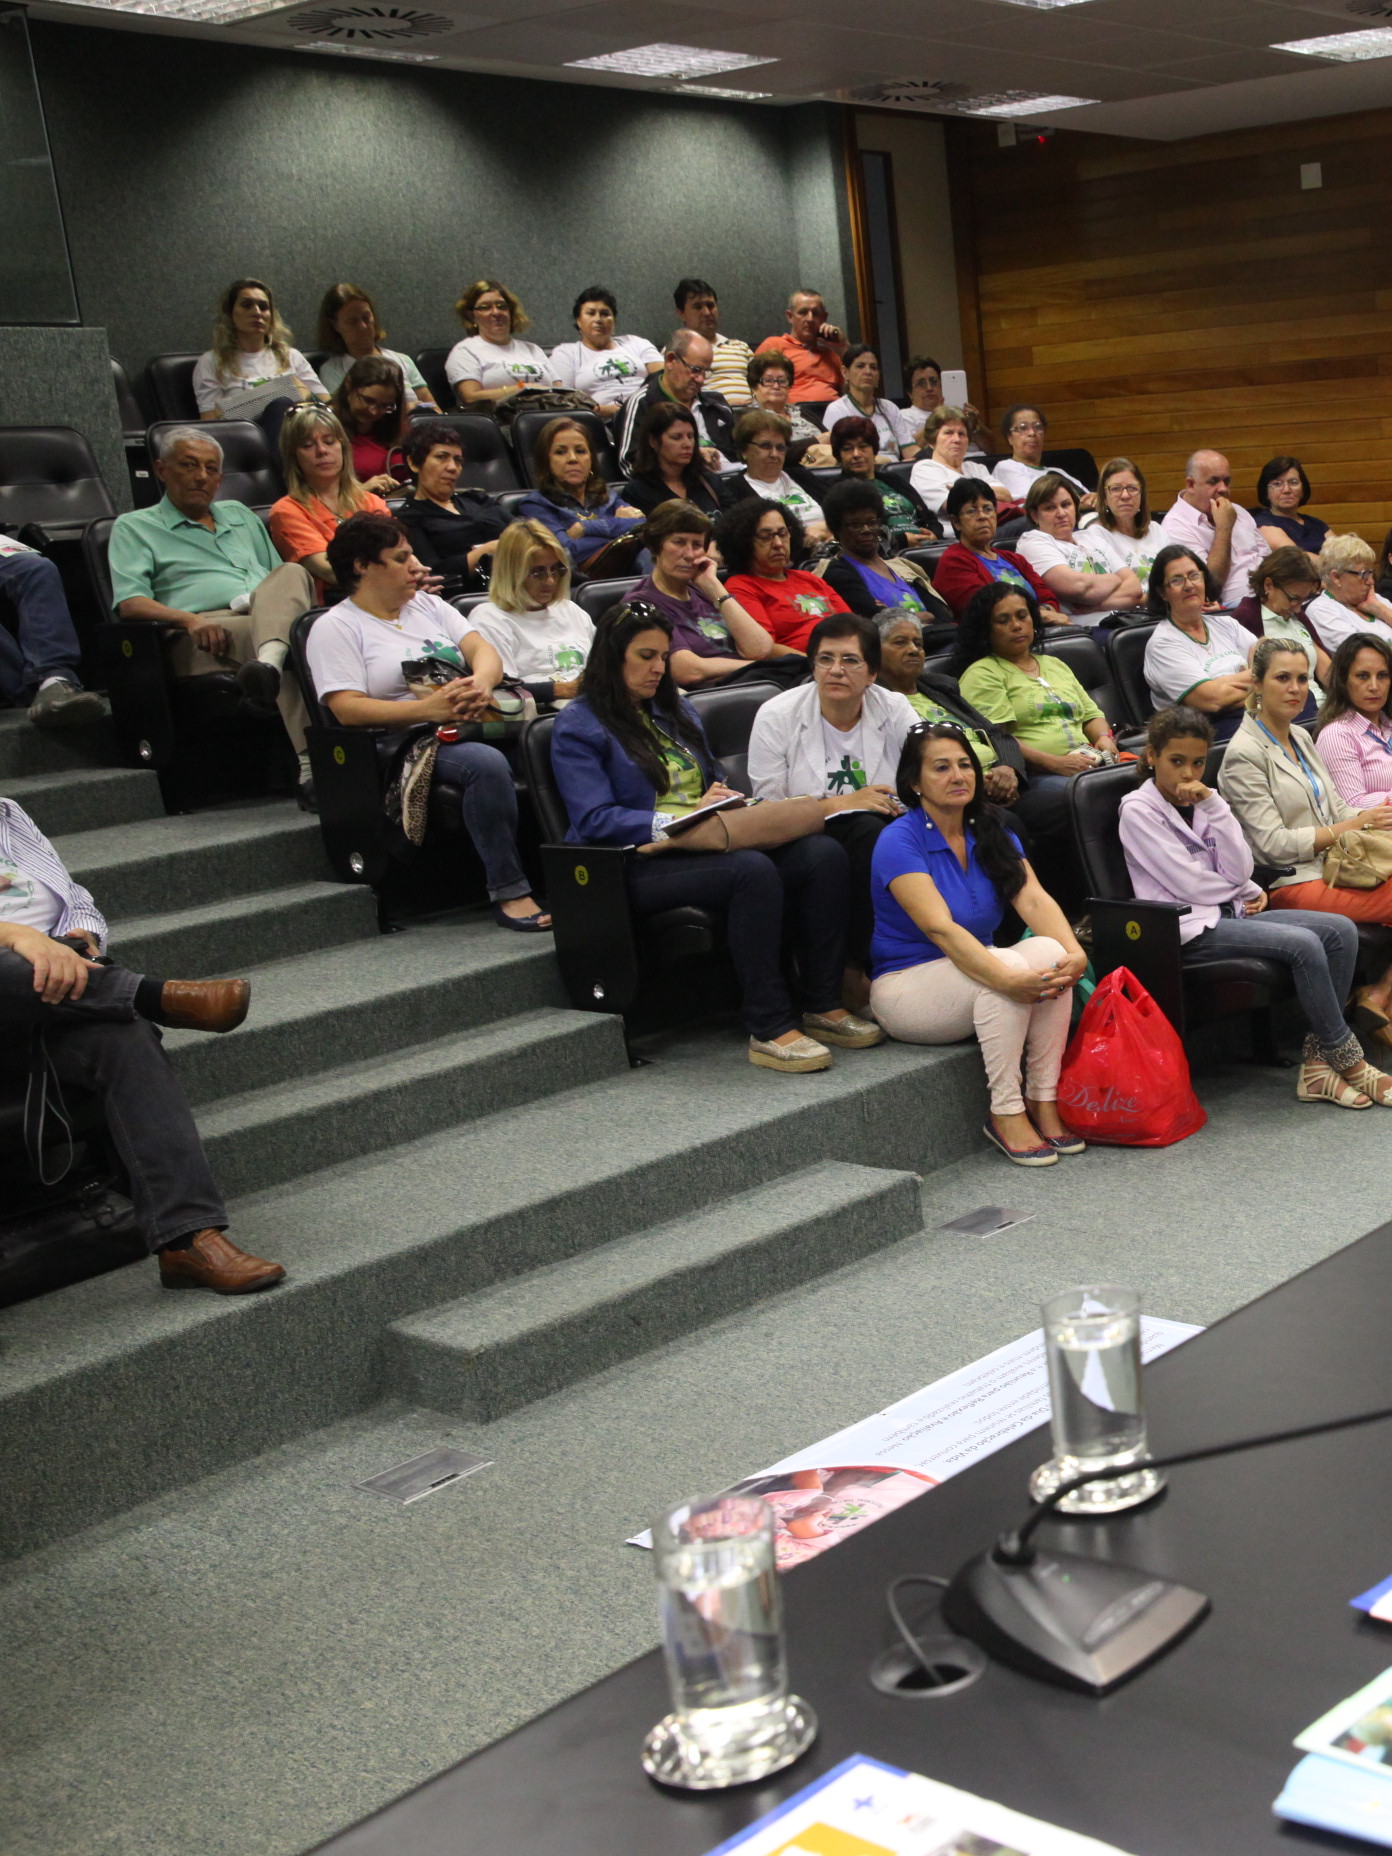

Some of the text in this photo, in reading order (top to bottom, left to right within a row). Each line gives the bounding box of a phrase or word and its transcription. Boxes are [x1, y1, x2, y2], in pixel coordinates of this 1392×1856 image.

[579, 870, 585, 881] B
[1130, 925, 1139, 935] A
[997, 1370, 1035, 1389] Reunião
[945, 1396, 986, 1418] Reflexão
[973, 1419, 1025, 1447] Celebração
